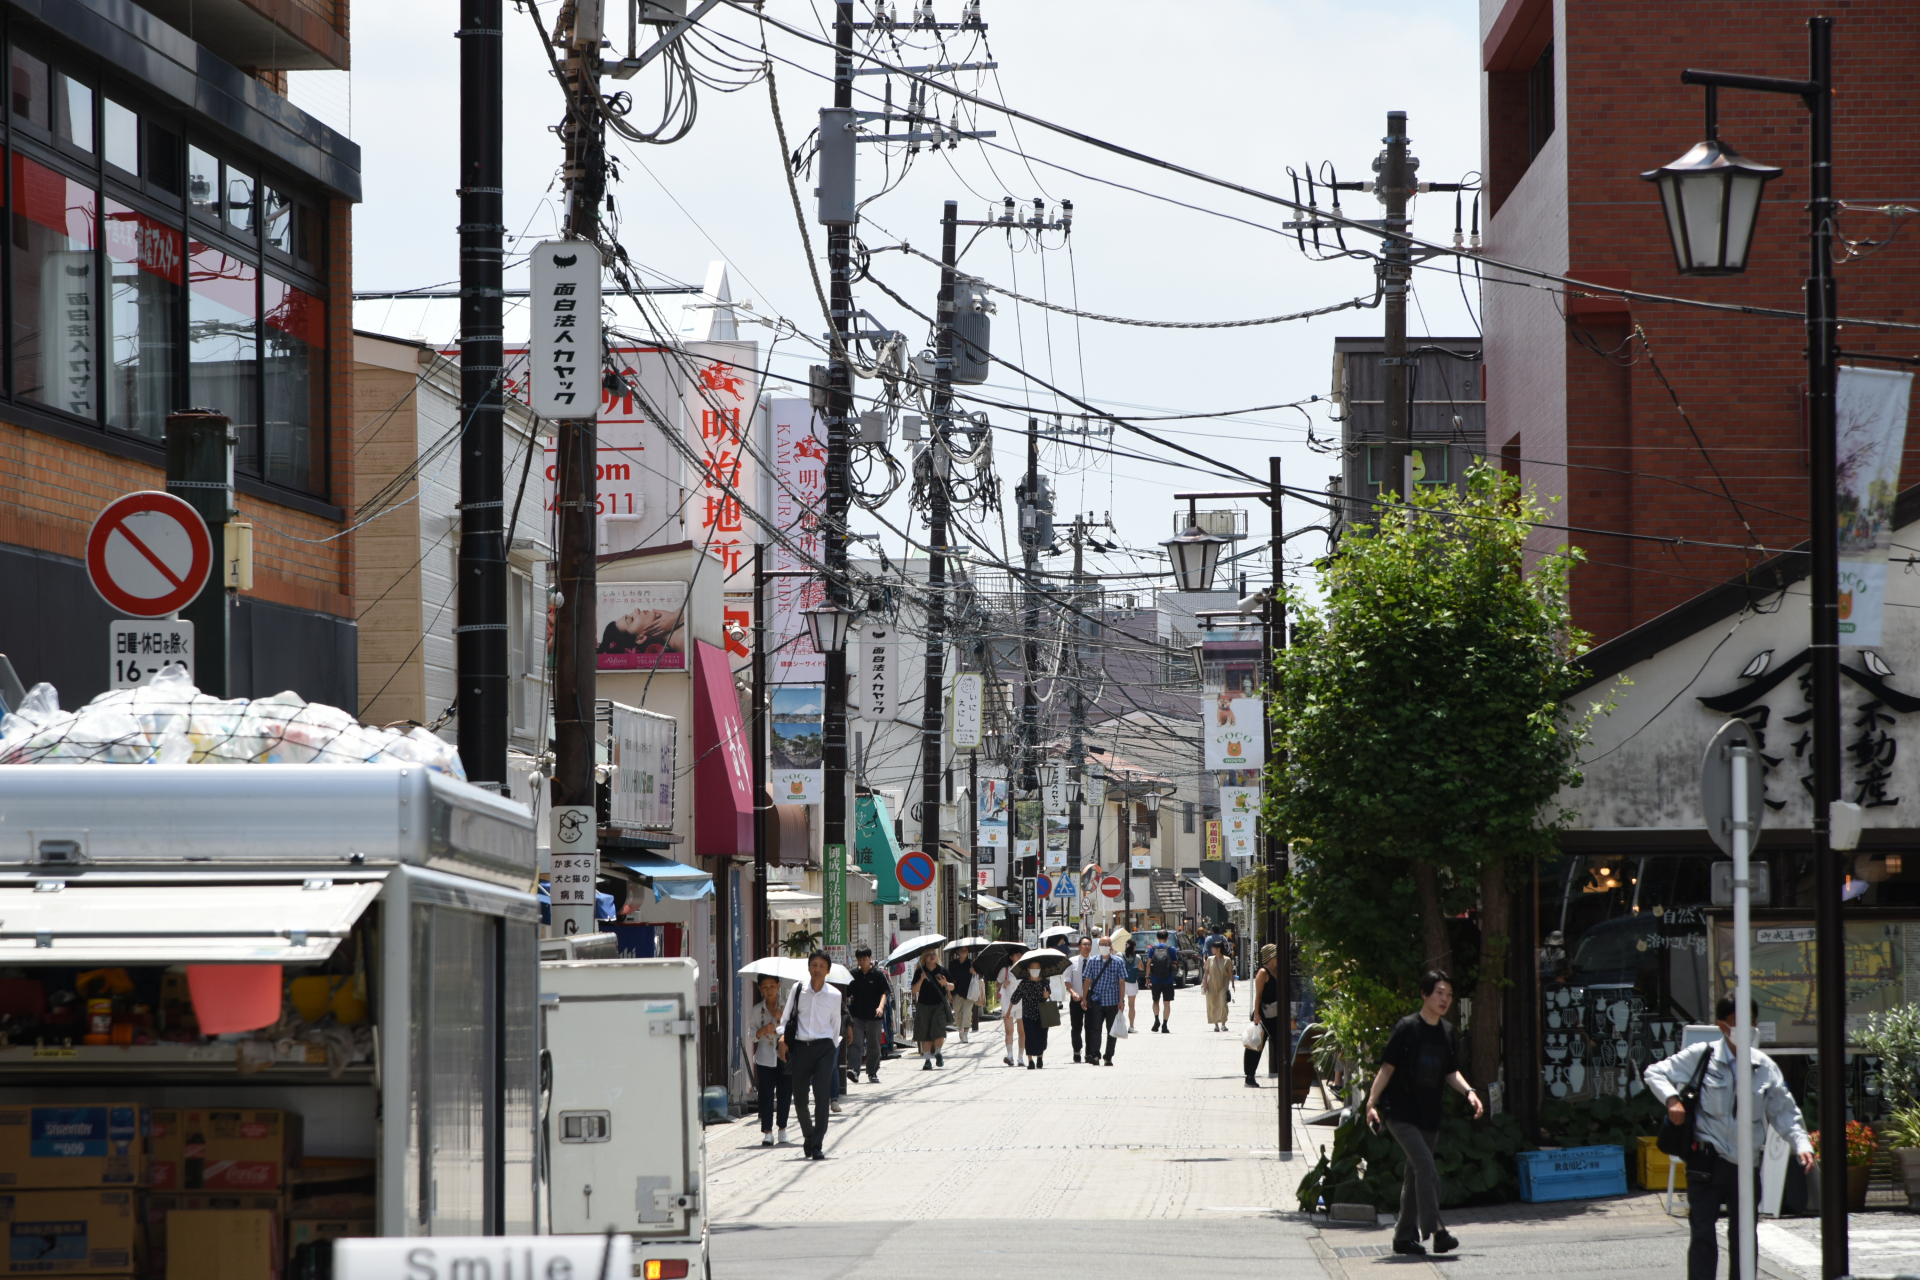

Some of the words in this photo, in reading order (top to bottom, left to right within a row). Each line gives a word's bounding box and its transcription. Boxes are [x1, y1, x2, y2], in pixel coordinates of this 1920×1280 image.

[553, 283, 577, 405] 面白法人カヤック
[702, 407, 742, 576] 明治地所
[117, 631, 188, 654] 日曜・休日を除く
[872, 646, 886, 714] 面白法人カヤック
[1216, 731, 1253, 744] COCO
[1846, 700, 1900, 809] 不動産
[782, 773, 812, 784] COCO
[554, 859, 591, 868] かまくら
[555, 874, 590, 884] 犬と猫の
[560, 890, 585, 900] 病院
[828, 847, 841, 944] 御成町法律事務所
[46, 1122, 93, 1136] AQUARIUS
